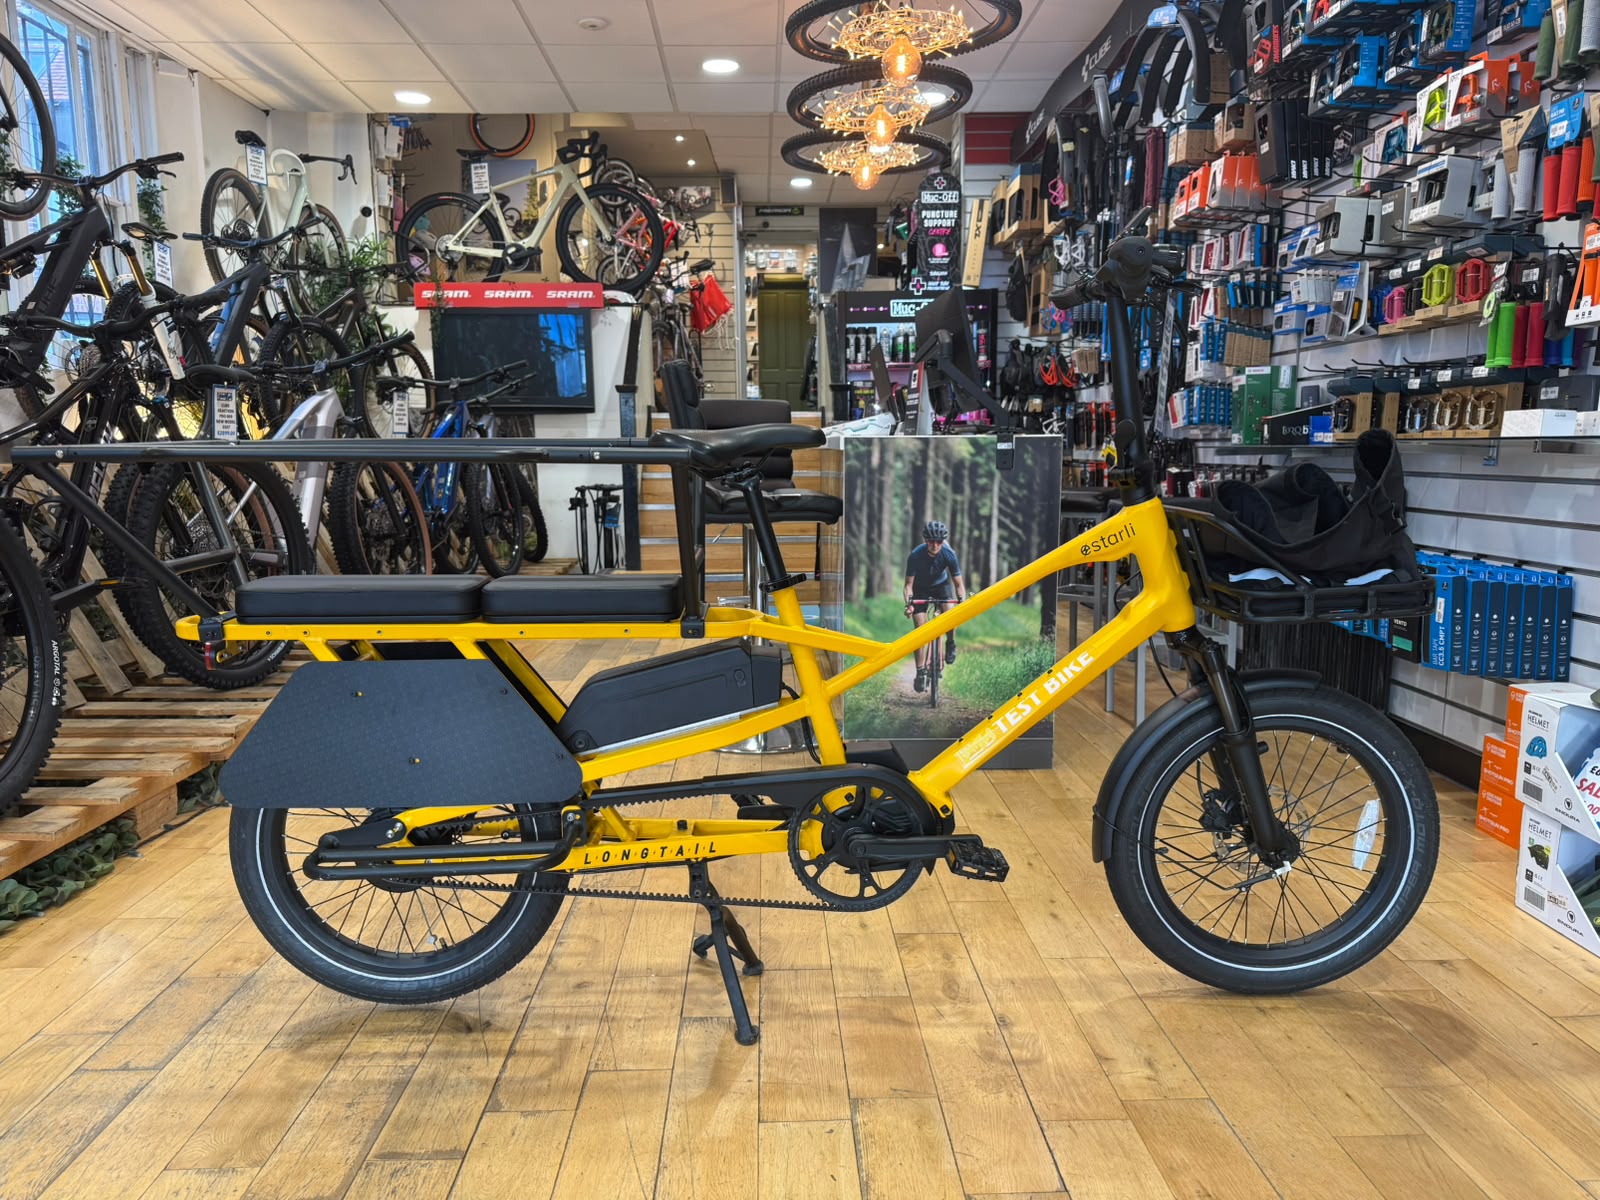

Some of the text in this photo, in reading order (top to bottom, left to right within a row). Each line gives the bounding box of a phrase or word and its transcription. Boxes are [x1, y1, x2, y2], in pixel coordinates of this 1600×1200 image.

[1089, 34, 1112, 70] CUBE
[923, 192, 956, 202] Muc-Off
[921, 210, 958, 219] PUNCTURE
[923, 219, 956, 228] SUPPORT
[1081, 523, 1136, 557] estarli
[51, 639, 61, 676] ARGOTAL
[992, 650, 1095, 734] TEST BIKE
[1527, 714, 1550, 730] HELMET
[1554, 807, 1581, 823] ENDURA
[1528, 822, 1552, 839] HELMET
[1557, 918, 1584, 937] ENDURA
